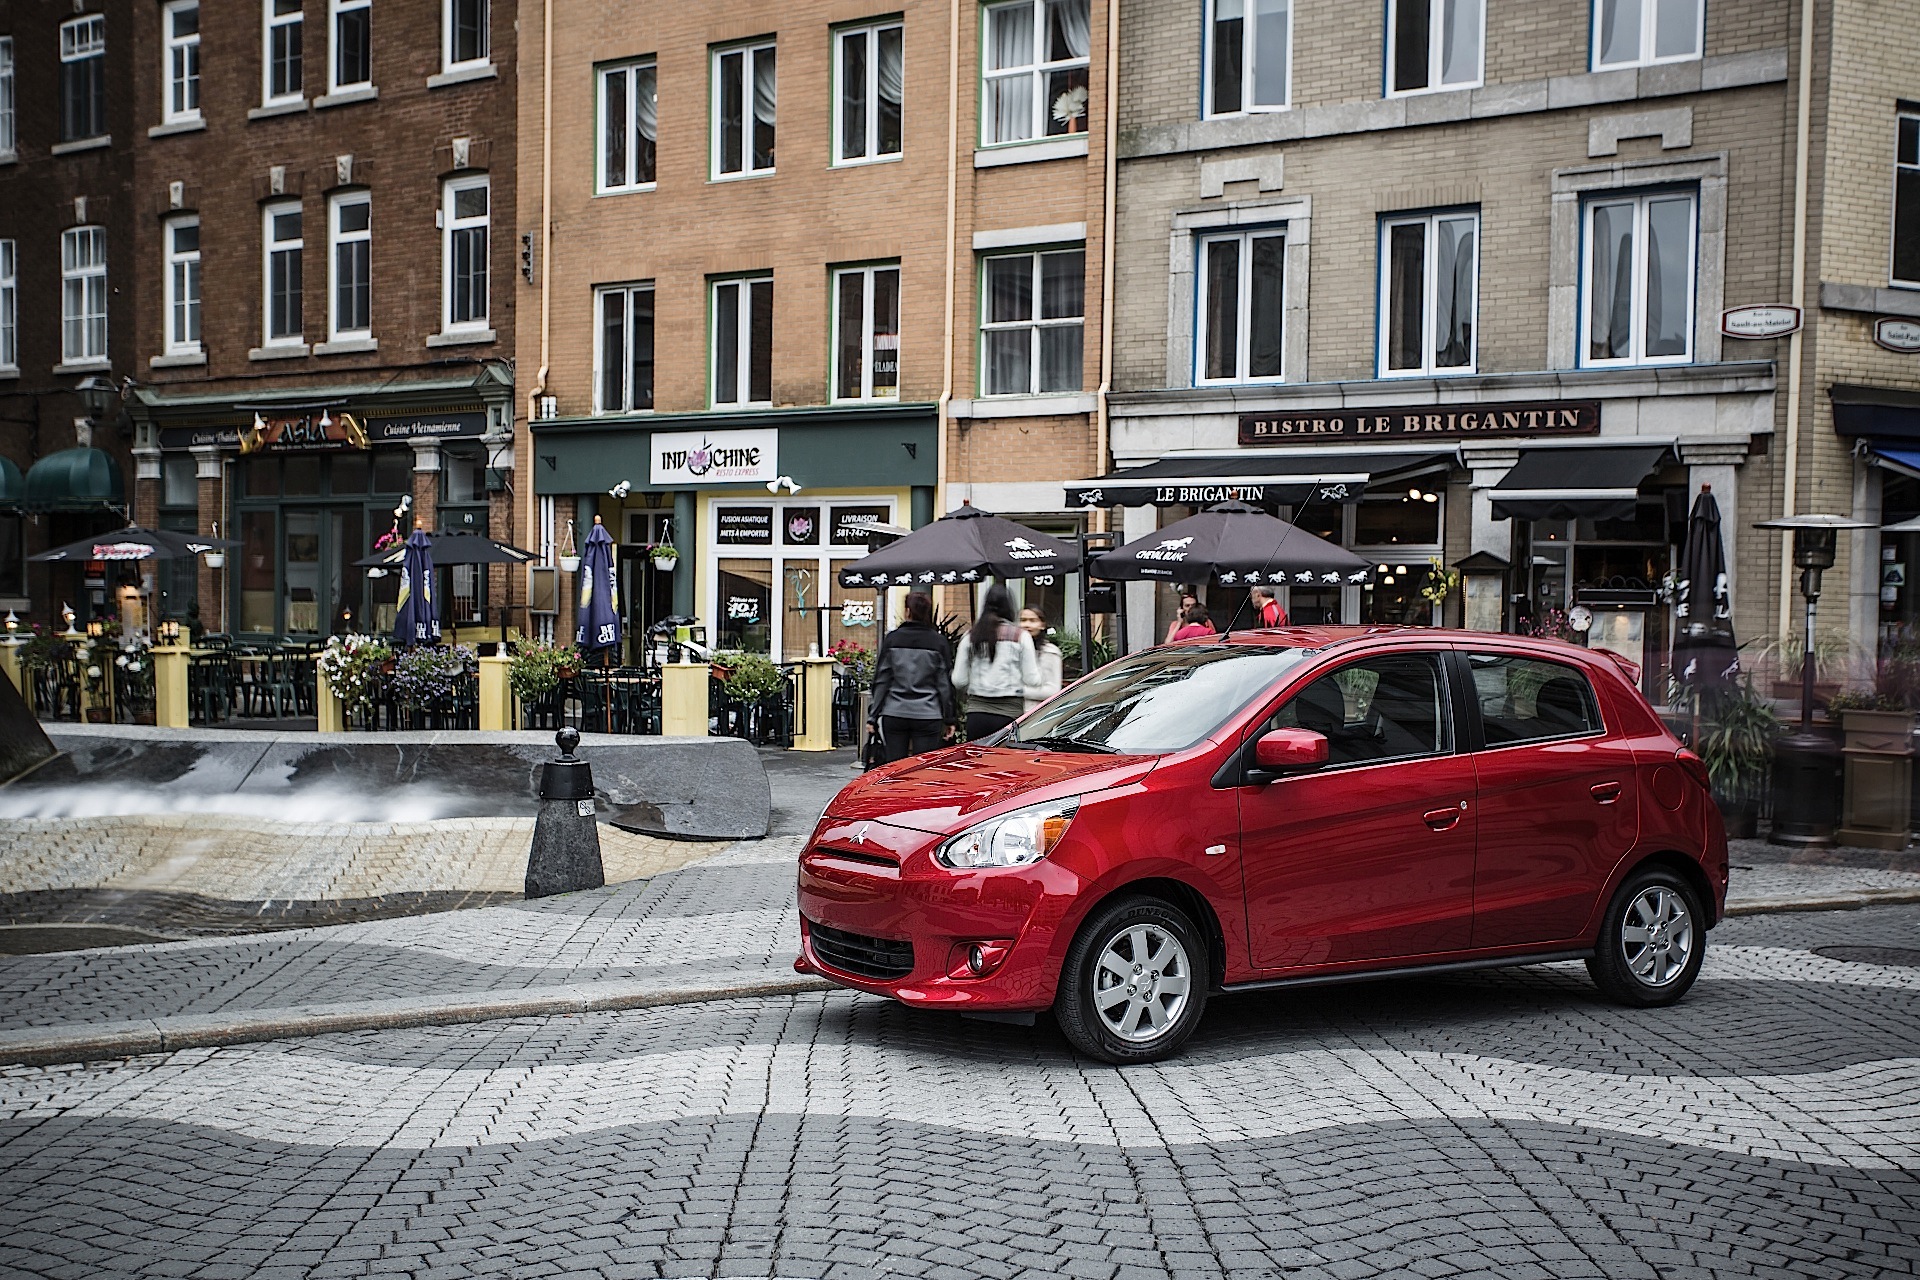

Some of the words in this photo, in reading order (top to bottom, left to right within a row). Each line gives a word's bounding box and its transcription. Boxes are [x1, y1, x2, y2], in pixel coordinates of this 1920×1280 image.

[384, 423, 410, 436] Cuisine
[412, 421, 461, 434] Vietnamienne
[1254, 418, 1344, 435] BISTRO
[1356, 416, 1390, 433] LE
[1403, 409, 1580, 432] BRIGANTIN
[661, 445, 762, 475] INDOCHINE
[735, 468, 760, 476] EXPRESS
[1156, 487, 1174, 501] LE
[1179, 486, 1264, 501] BRIGANTIN
[741, 516, 768, 524] ASIATIQUE
[842, 515, 878, 523] LIVRAISON
[1136, 550, 1164, 560] CHEVAL
[1162, 552, 1188, 561] BLANC
